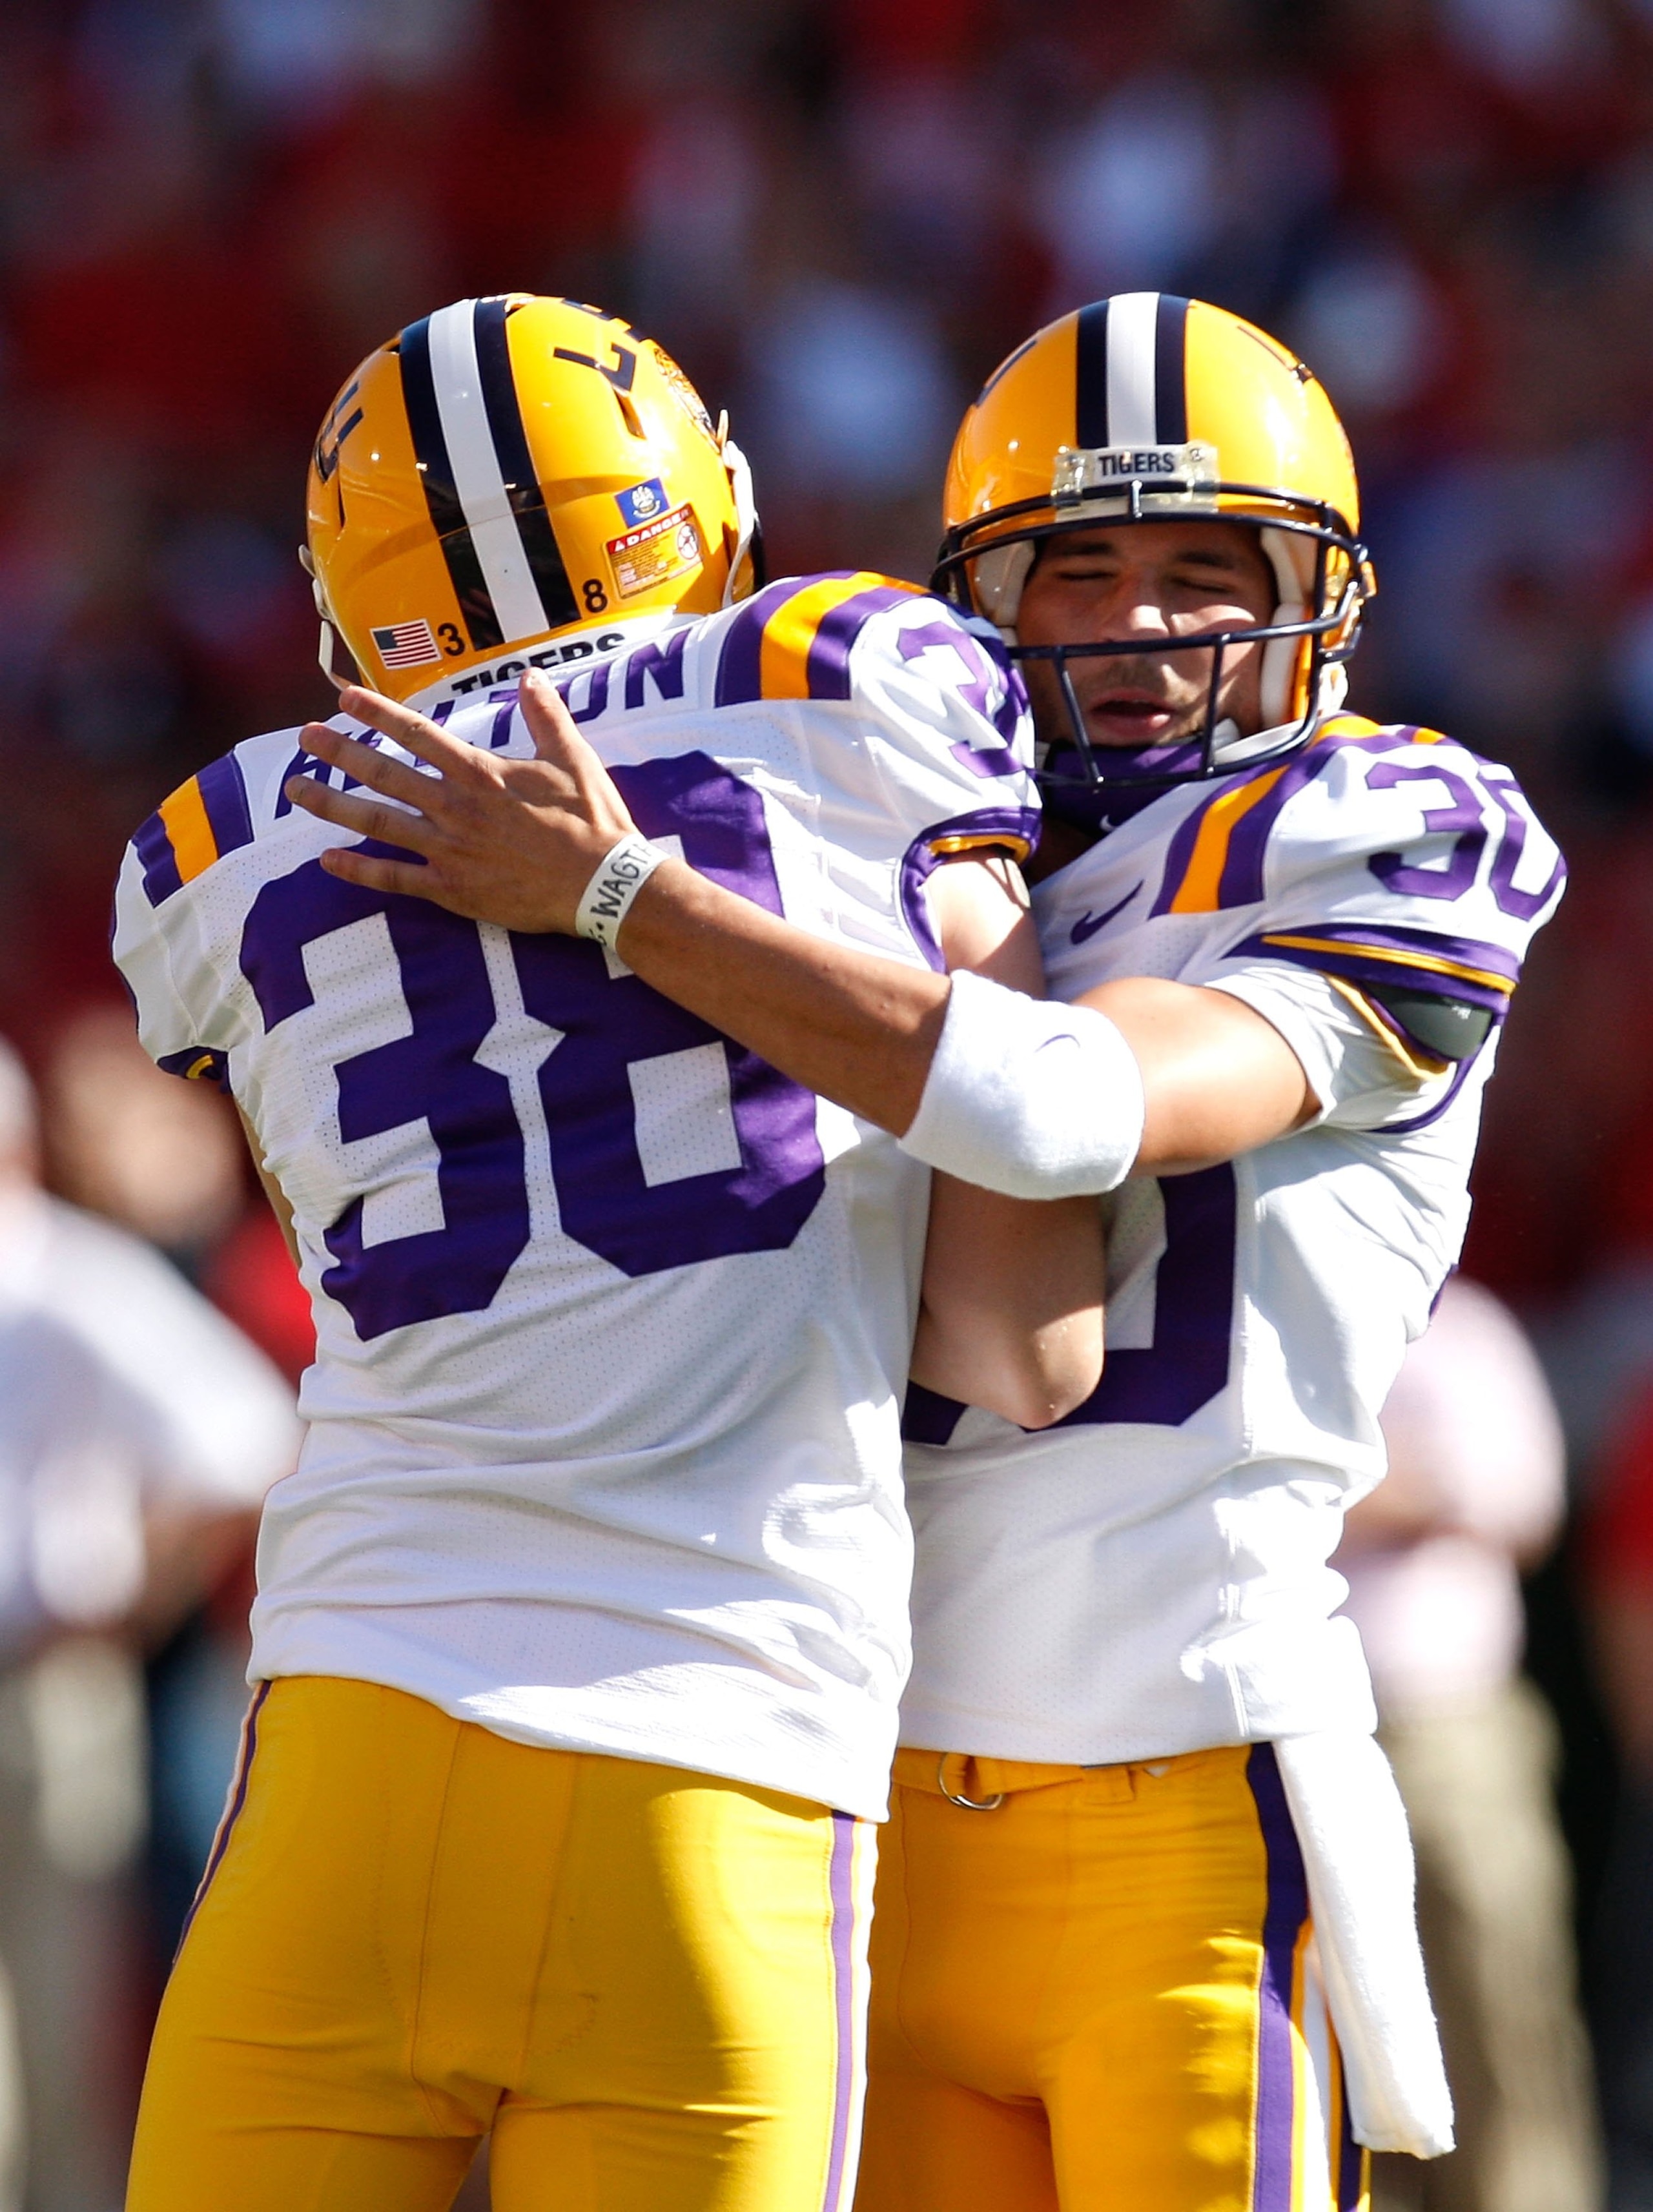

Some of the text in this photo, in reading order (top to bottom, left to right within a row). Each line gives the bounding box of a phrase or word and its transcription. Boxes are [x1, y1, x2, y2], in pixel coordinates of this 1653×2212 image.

[1098, 452, 1175, 476] TIGERS
[437, 579, 608, 656] 3 8
[1364, 762, 1568, 922] 30
[240, 750, 826, 1342] 38
